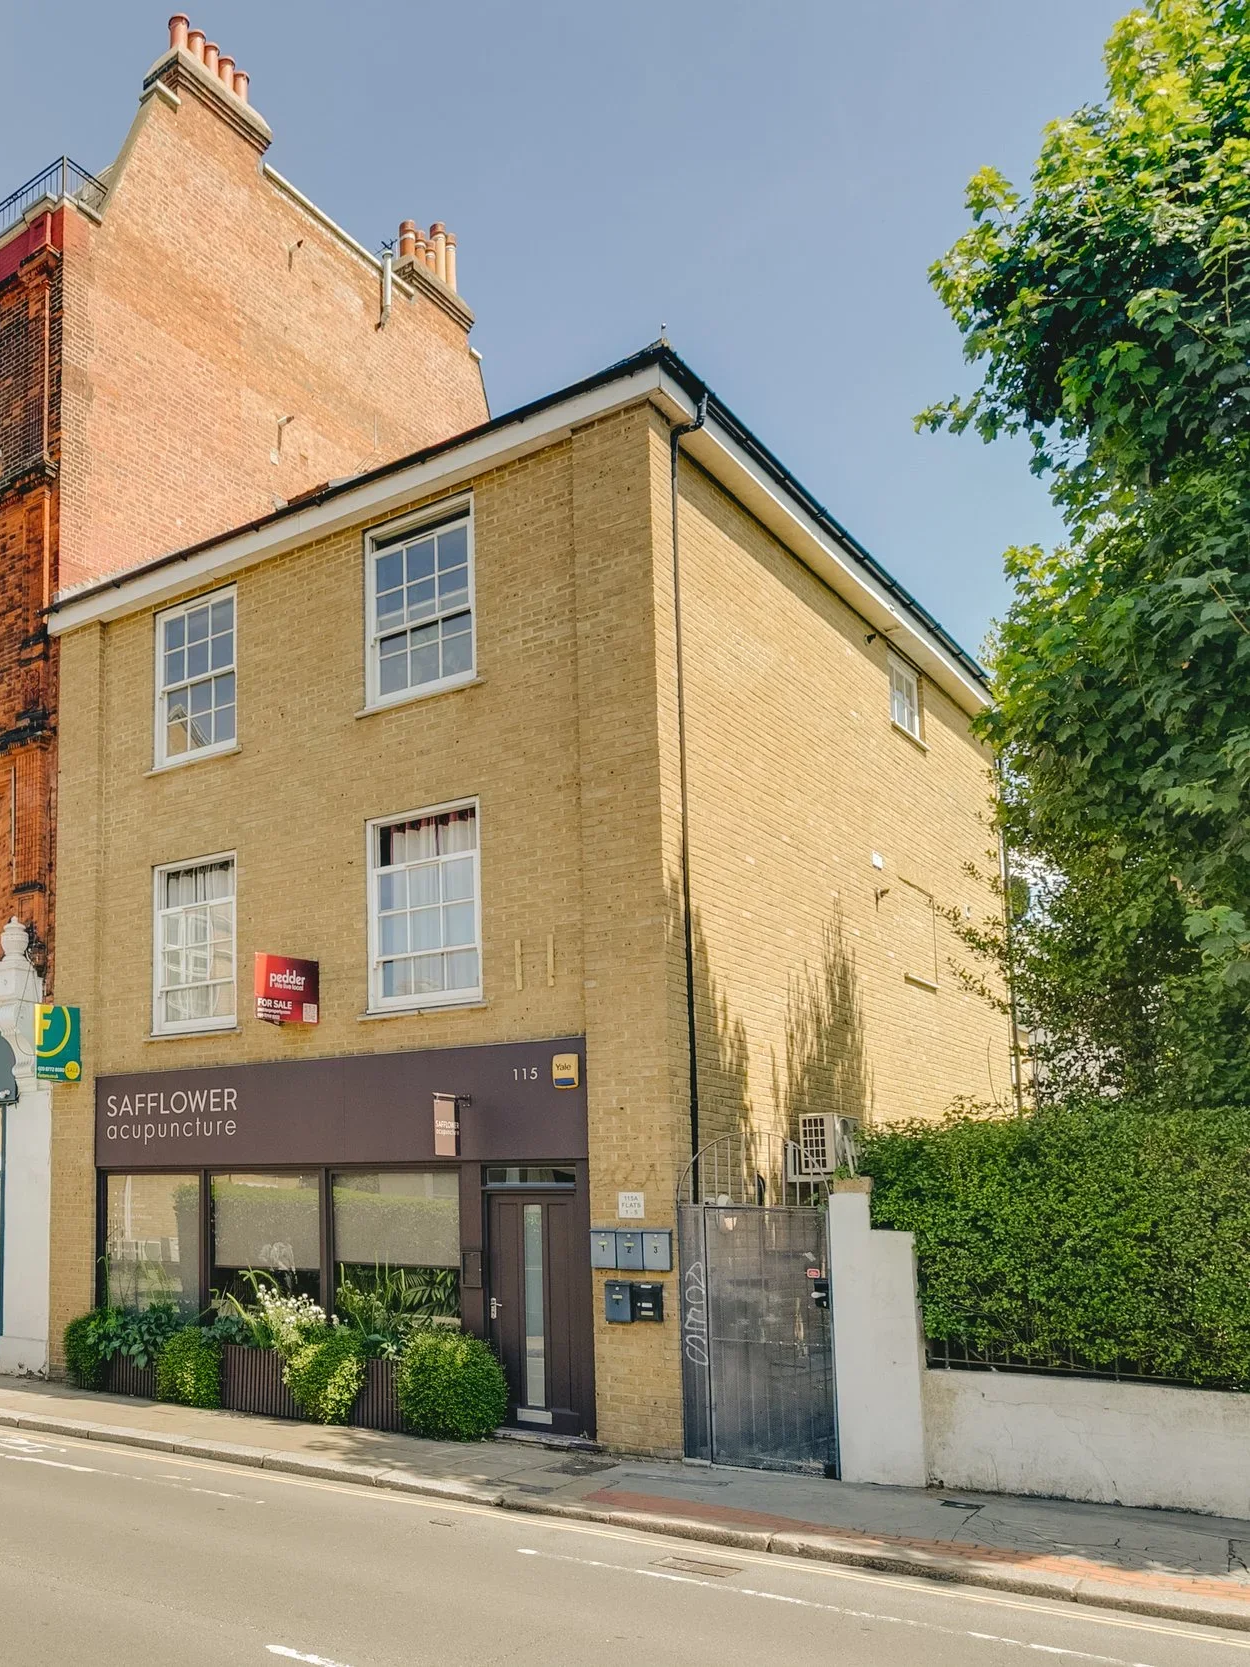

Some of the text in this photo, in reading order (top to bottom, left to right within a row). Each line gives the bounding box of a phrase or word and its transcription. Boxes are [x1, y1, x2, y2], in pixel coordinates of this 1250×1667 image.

[270, 969, 305, 987] pedder
[257, 997, 292, 1010] FOR SALE
[555, 1063, 571, 1071] Yale
[513, 1067, 538, 1081] 115
[107, 1088, 237, 1117] SAFFLOWER
[106, 1117, 237, 1145] acupuncture
[627, 1246, 631, 1254] 2
[653, 1246, 658, 1254] 3
